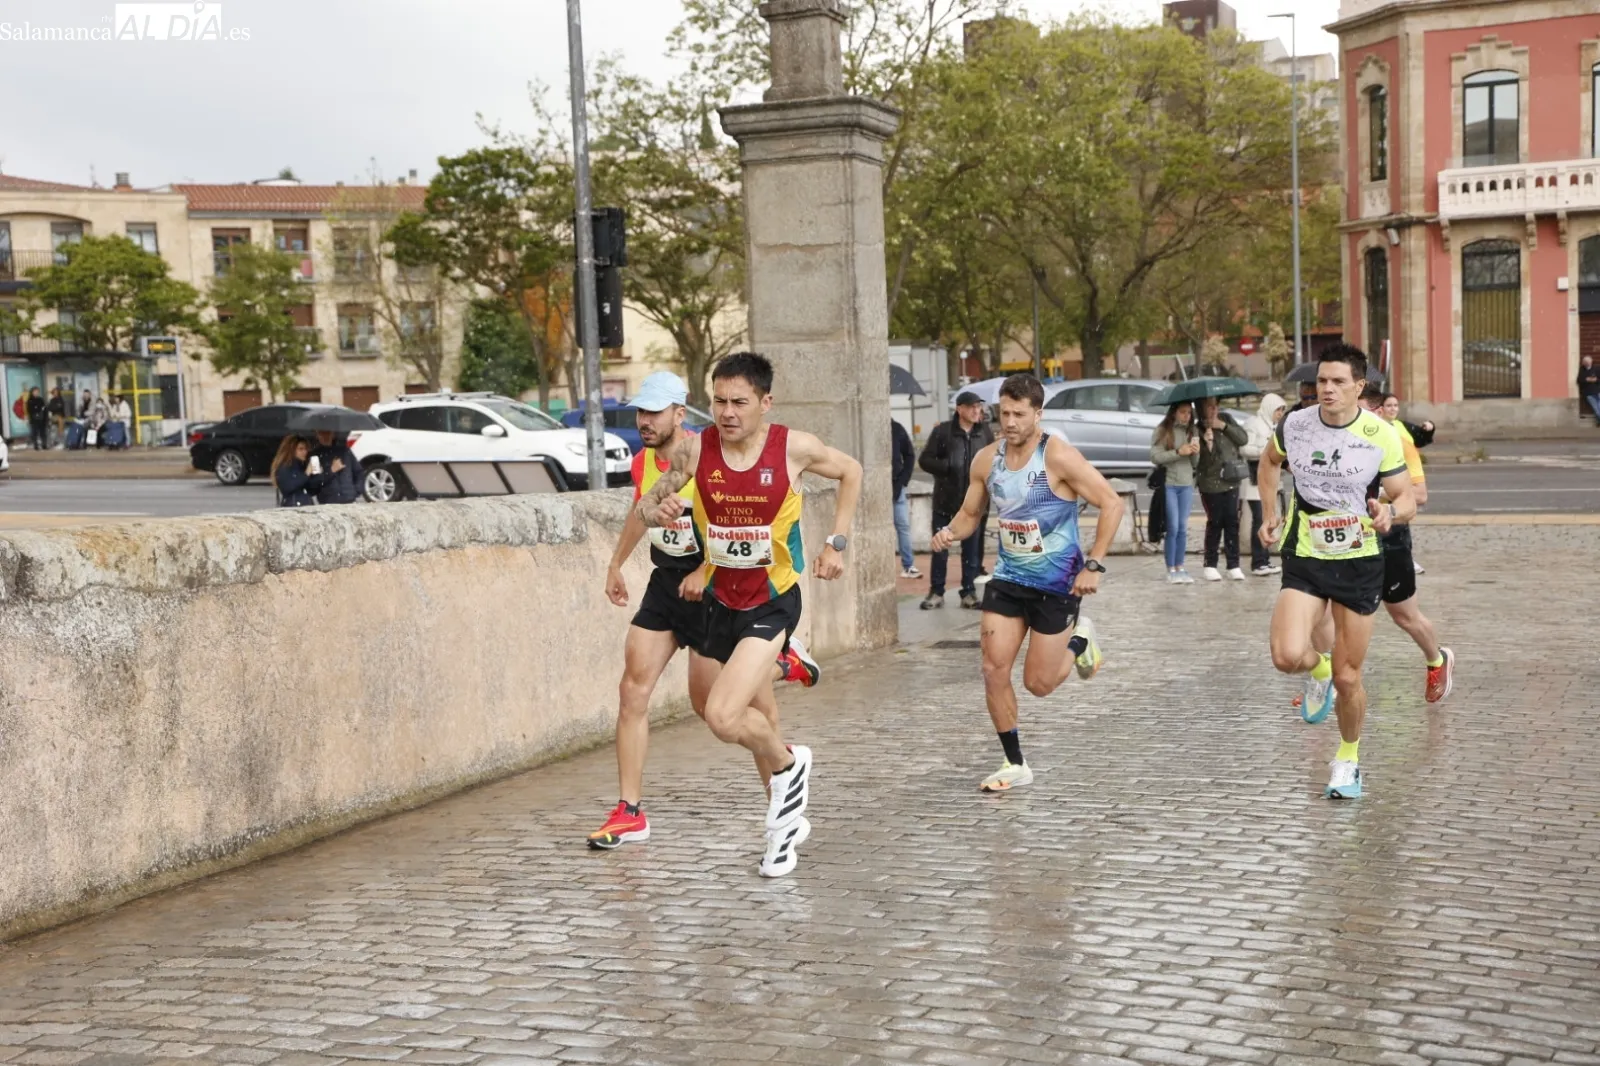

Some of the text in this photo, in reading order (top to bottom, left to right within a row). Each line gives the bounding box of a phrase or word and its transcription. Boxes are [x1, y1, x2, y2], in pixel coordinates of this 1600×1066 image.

[1302, 466, 1346, 479] Corralina,
[726, 495, 769, 503] CAJA RURAL
[725, 507, 753, 516] VINO
[716, 515, 763, 525] DE TORO
[1308, 515, 1359, 529] bedunia
[662, 529, 679, 545] 62
[708, 527, 769, 541] bedunia
[1009, 531, 1026, 545] 75
[1323, 527, 1346, 543] 85
[726, 540, 752, 557] 48
